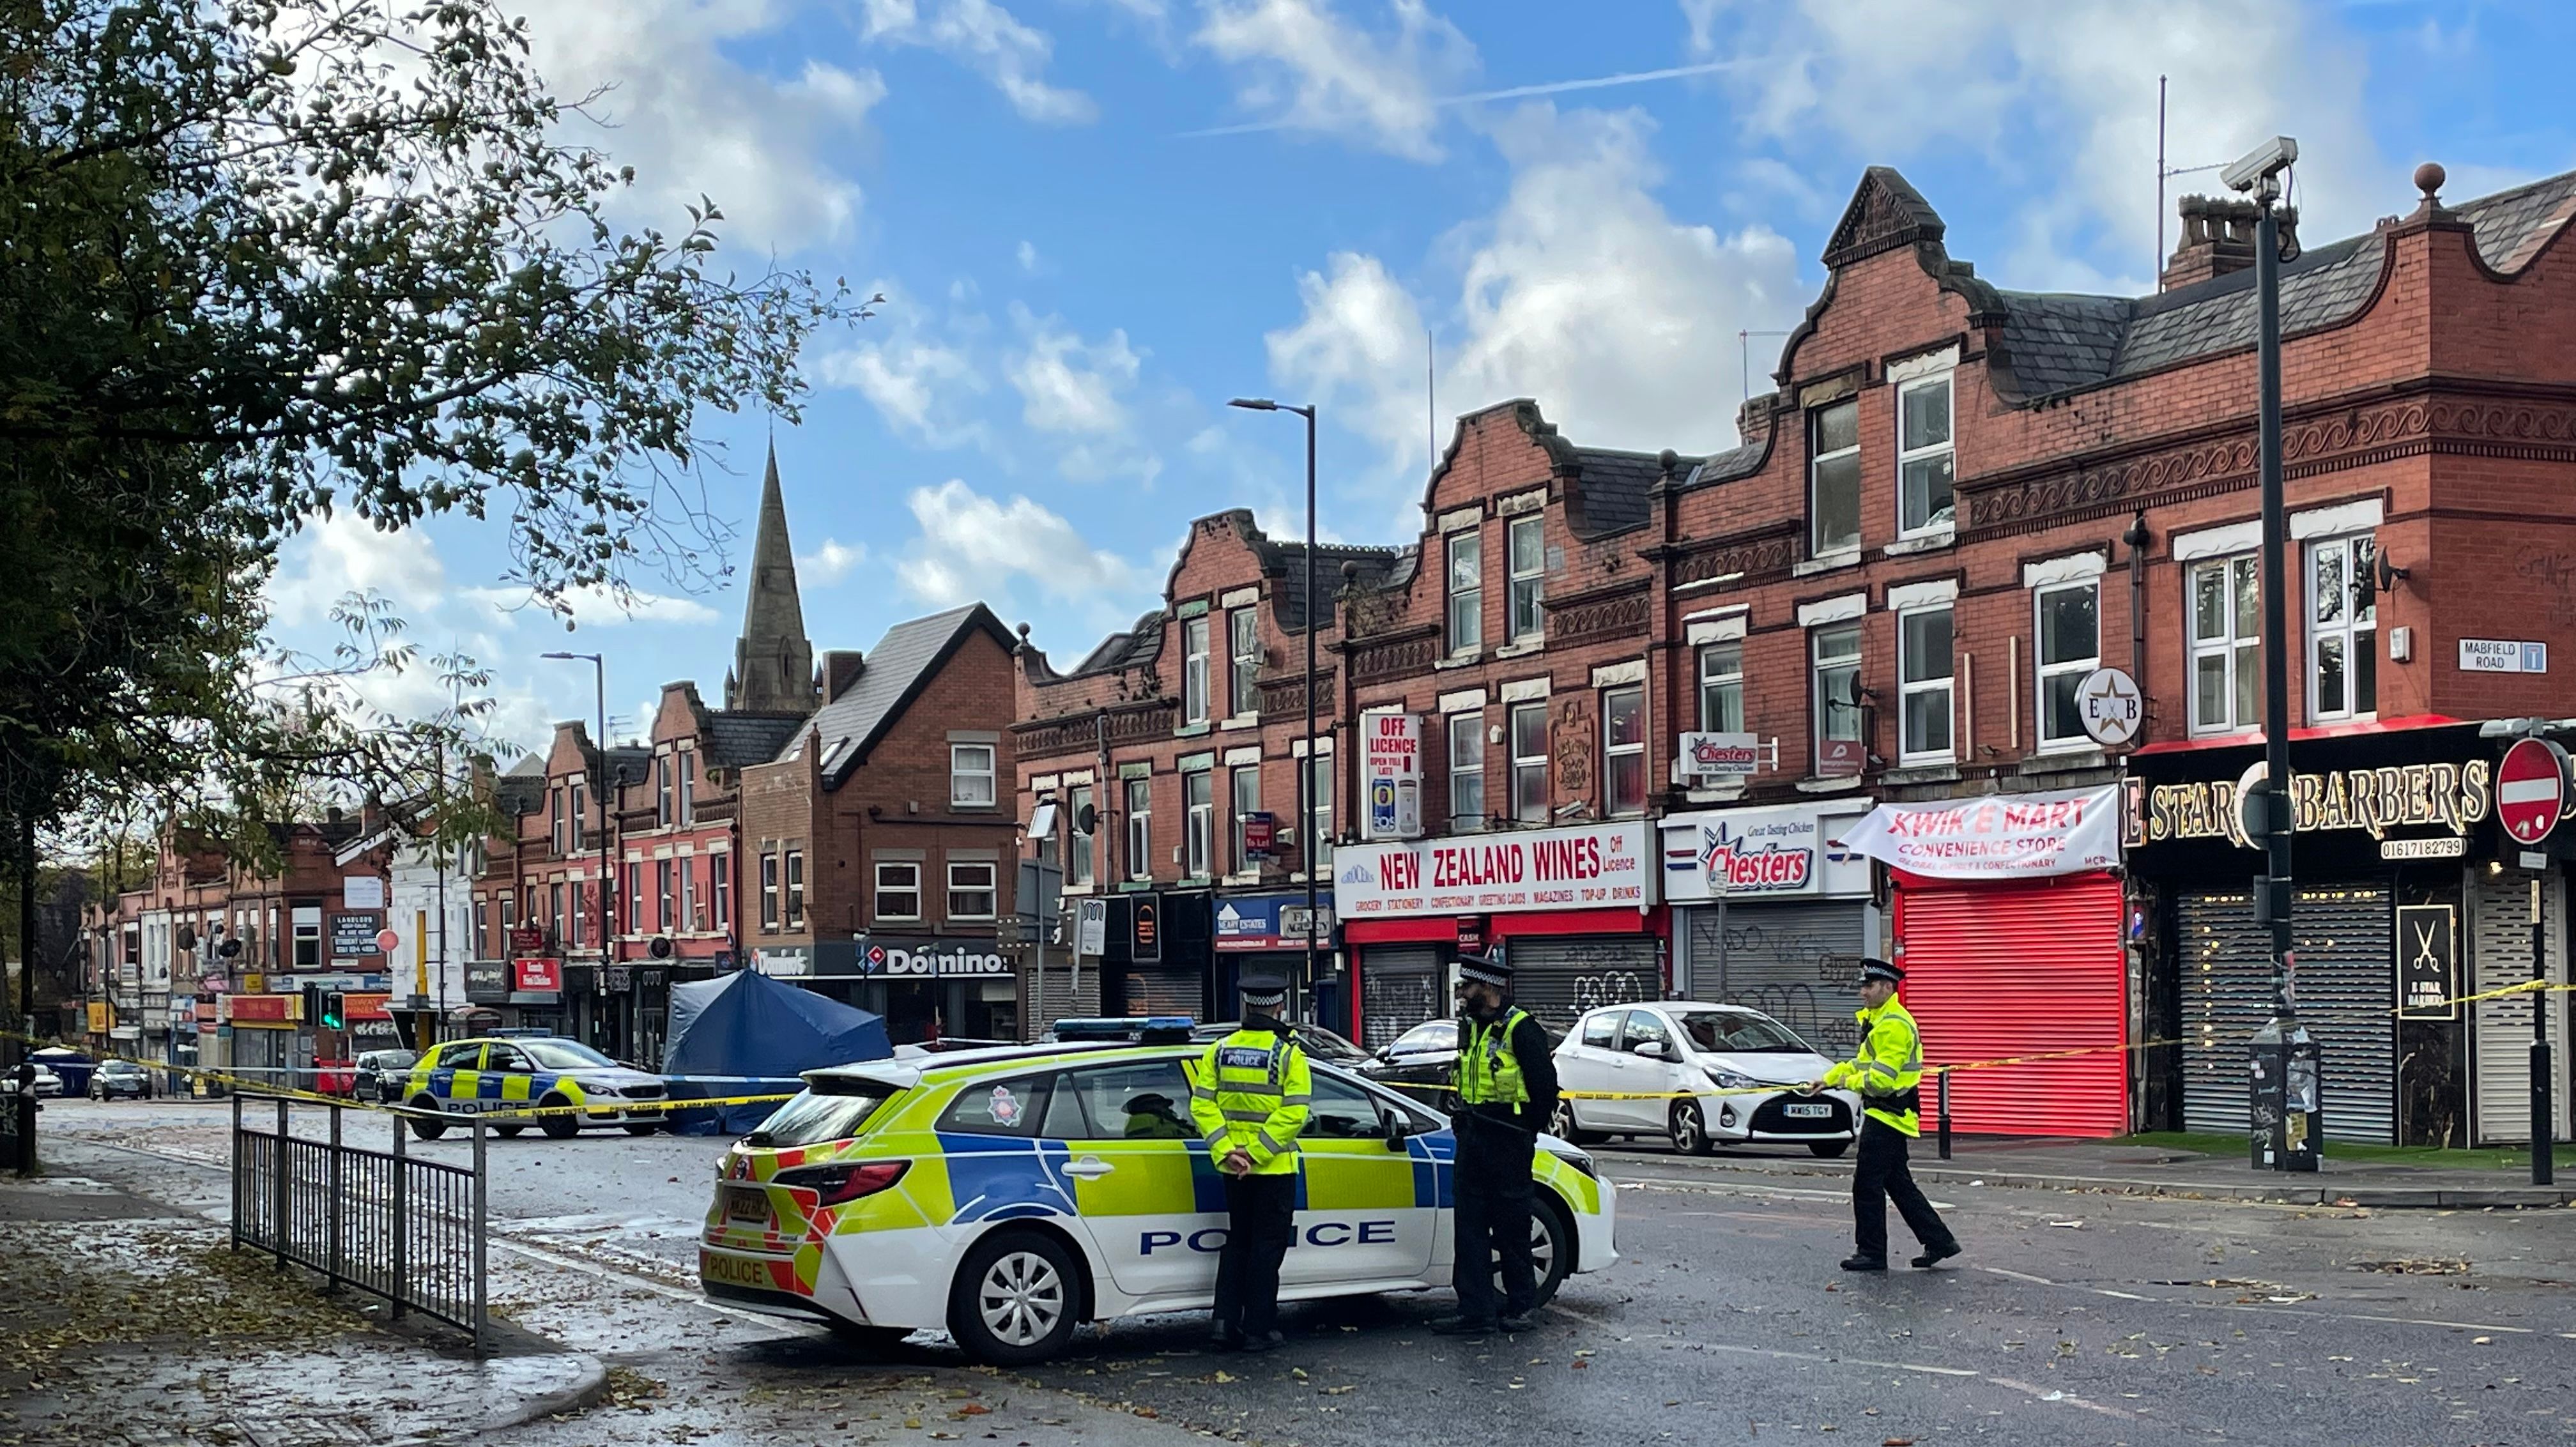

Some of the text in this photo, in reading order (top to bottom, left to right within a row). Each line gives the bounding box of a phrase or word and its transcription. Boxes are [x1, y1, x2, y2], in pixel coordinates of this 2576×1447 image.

[2465, 641, 2515, 655] MABFIELD
[2476, 656, 2504, 668] ROAD
[1380, 717, 1406, 737] OFF
[1369, 738, 1416, 753] LICENCE
[1698, 743, 1756, 762] Chesters
[1370, 756, 1387, 766] OPEN
[1378, 767, 1393, 776] LATE
[2119, 776, 2147, 848] E
[2150, 781, 2242, 848] STAR
[2295, 759, 2489, 841] BARBERS
[1887, 798, 2091, 838] KWIK E MART
[1747, 825, 1766, 837] Great
[1788, 822, 1814, 834] Chicken
[1246, 838, 1269, 847] To Let
[1609, 835, 1623, 854] Off
[1897, 836, 2067, 857] CONVENIENCE STORE
[2382, 839, 2462, 857] 01617182799
[1380, 836, 1600, 891] NEW ZEALAND WINES
[1602, 854, 1635, 873] Licence
[1708, 845, 1806, 884] Chesters
[2084, 855, 2107, 866] MCR
[1533, 889, 1574, 903] MAGAZINES
[1459, 933, 1479, 942] CASH
[886, 947, 1008, 974] Domino
[2419, 981, 2442, 994] STAR
[1227, 1055, 1261, 1067] POLICE
[447, 1101, 530, 1115] POLICE
[1140, 1220, 1395, 1255] POICE
[710, 1256, 763, 1284] POLICE
